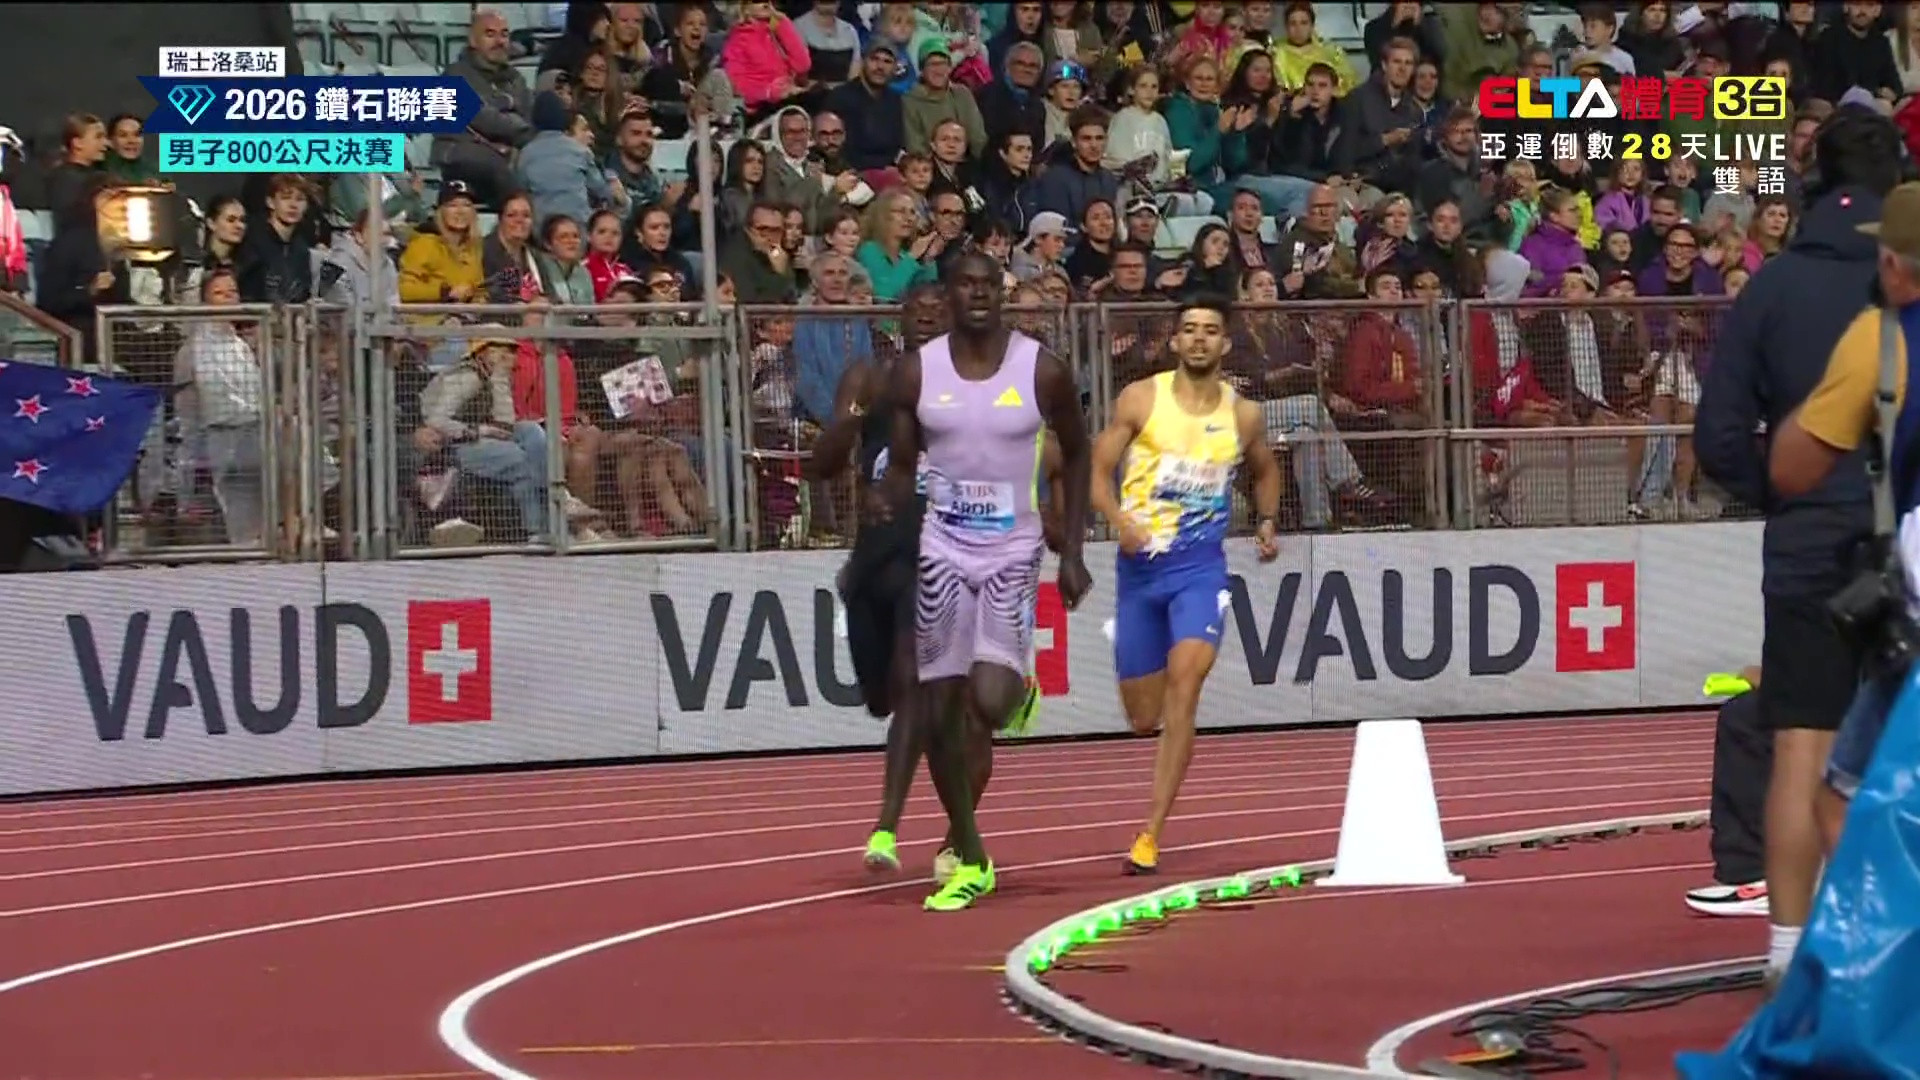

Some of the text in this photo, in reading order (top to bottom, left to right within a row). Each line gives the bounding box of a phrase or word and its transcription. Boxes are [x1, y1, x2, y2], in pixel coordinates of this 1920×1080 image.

[66, 602, 391, 741] VAUD
[650, 588, 866, 712] VAU
[1228, 565, 1540, 685] VAUD
